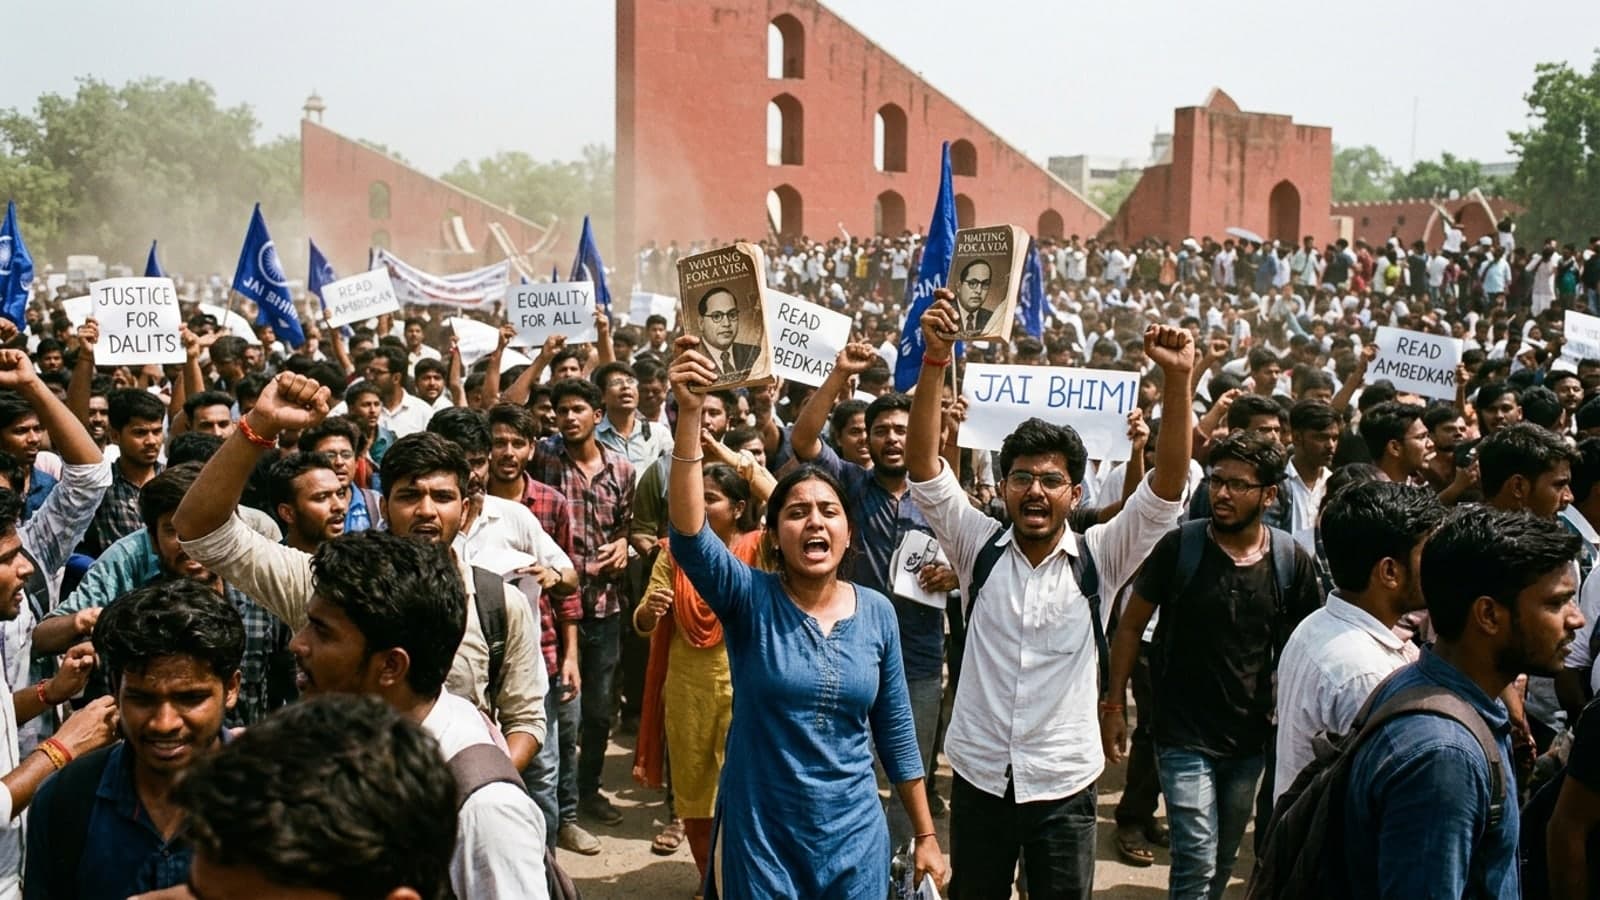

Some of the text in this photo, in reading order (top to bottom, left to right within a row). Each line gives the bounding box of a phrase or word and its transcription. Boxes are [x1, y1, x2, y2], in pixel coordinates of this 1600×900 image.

[711, 268, 720, 278] A
[722, 262, 749, 275] VISA
[99, 286, 172, 307] JUSTICE
[338, 279, 373, 297] READ
[517, 290, 589, 309] EQUALITY
[126, 311, 160, 329] FOR
[521, 311, 581, 328] FOR ALL
[777, 302, 821, 331] READ
[109, 333, 176, 354] DALITS
[780, 328, 810, 349] FOR
[1396, 336, 1442, 360] READ
[773, 346, 834, 378] BEDKAR
[1373, 357, 1454, 387] AMBEDKAR
[975, 373, 1137, 414] JAI BHIM!
